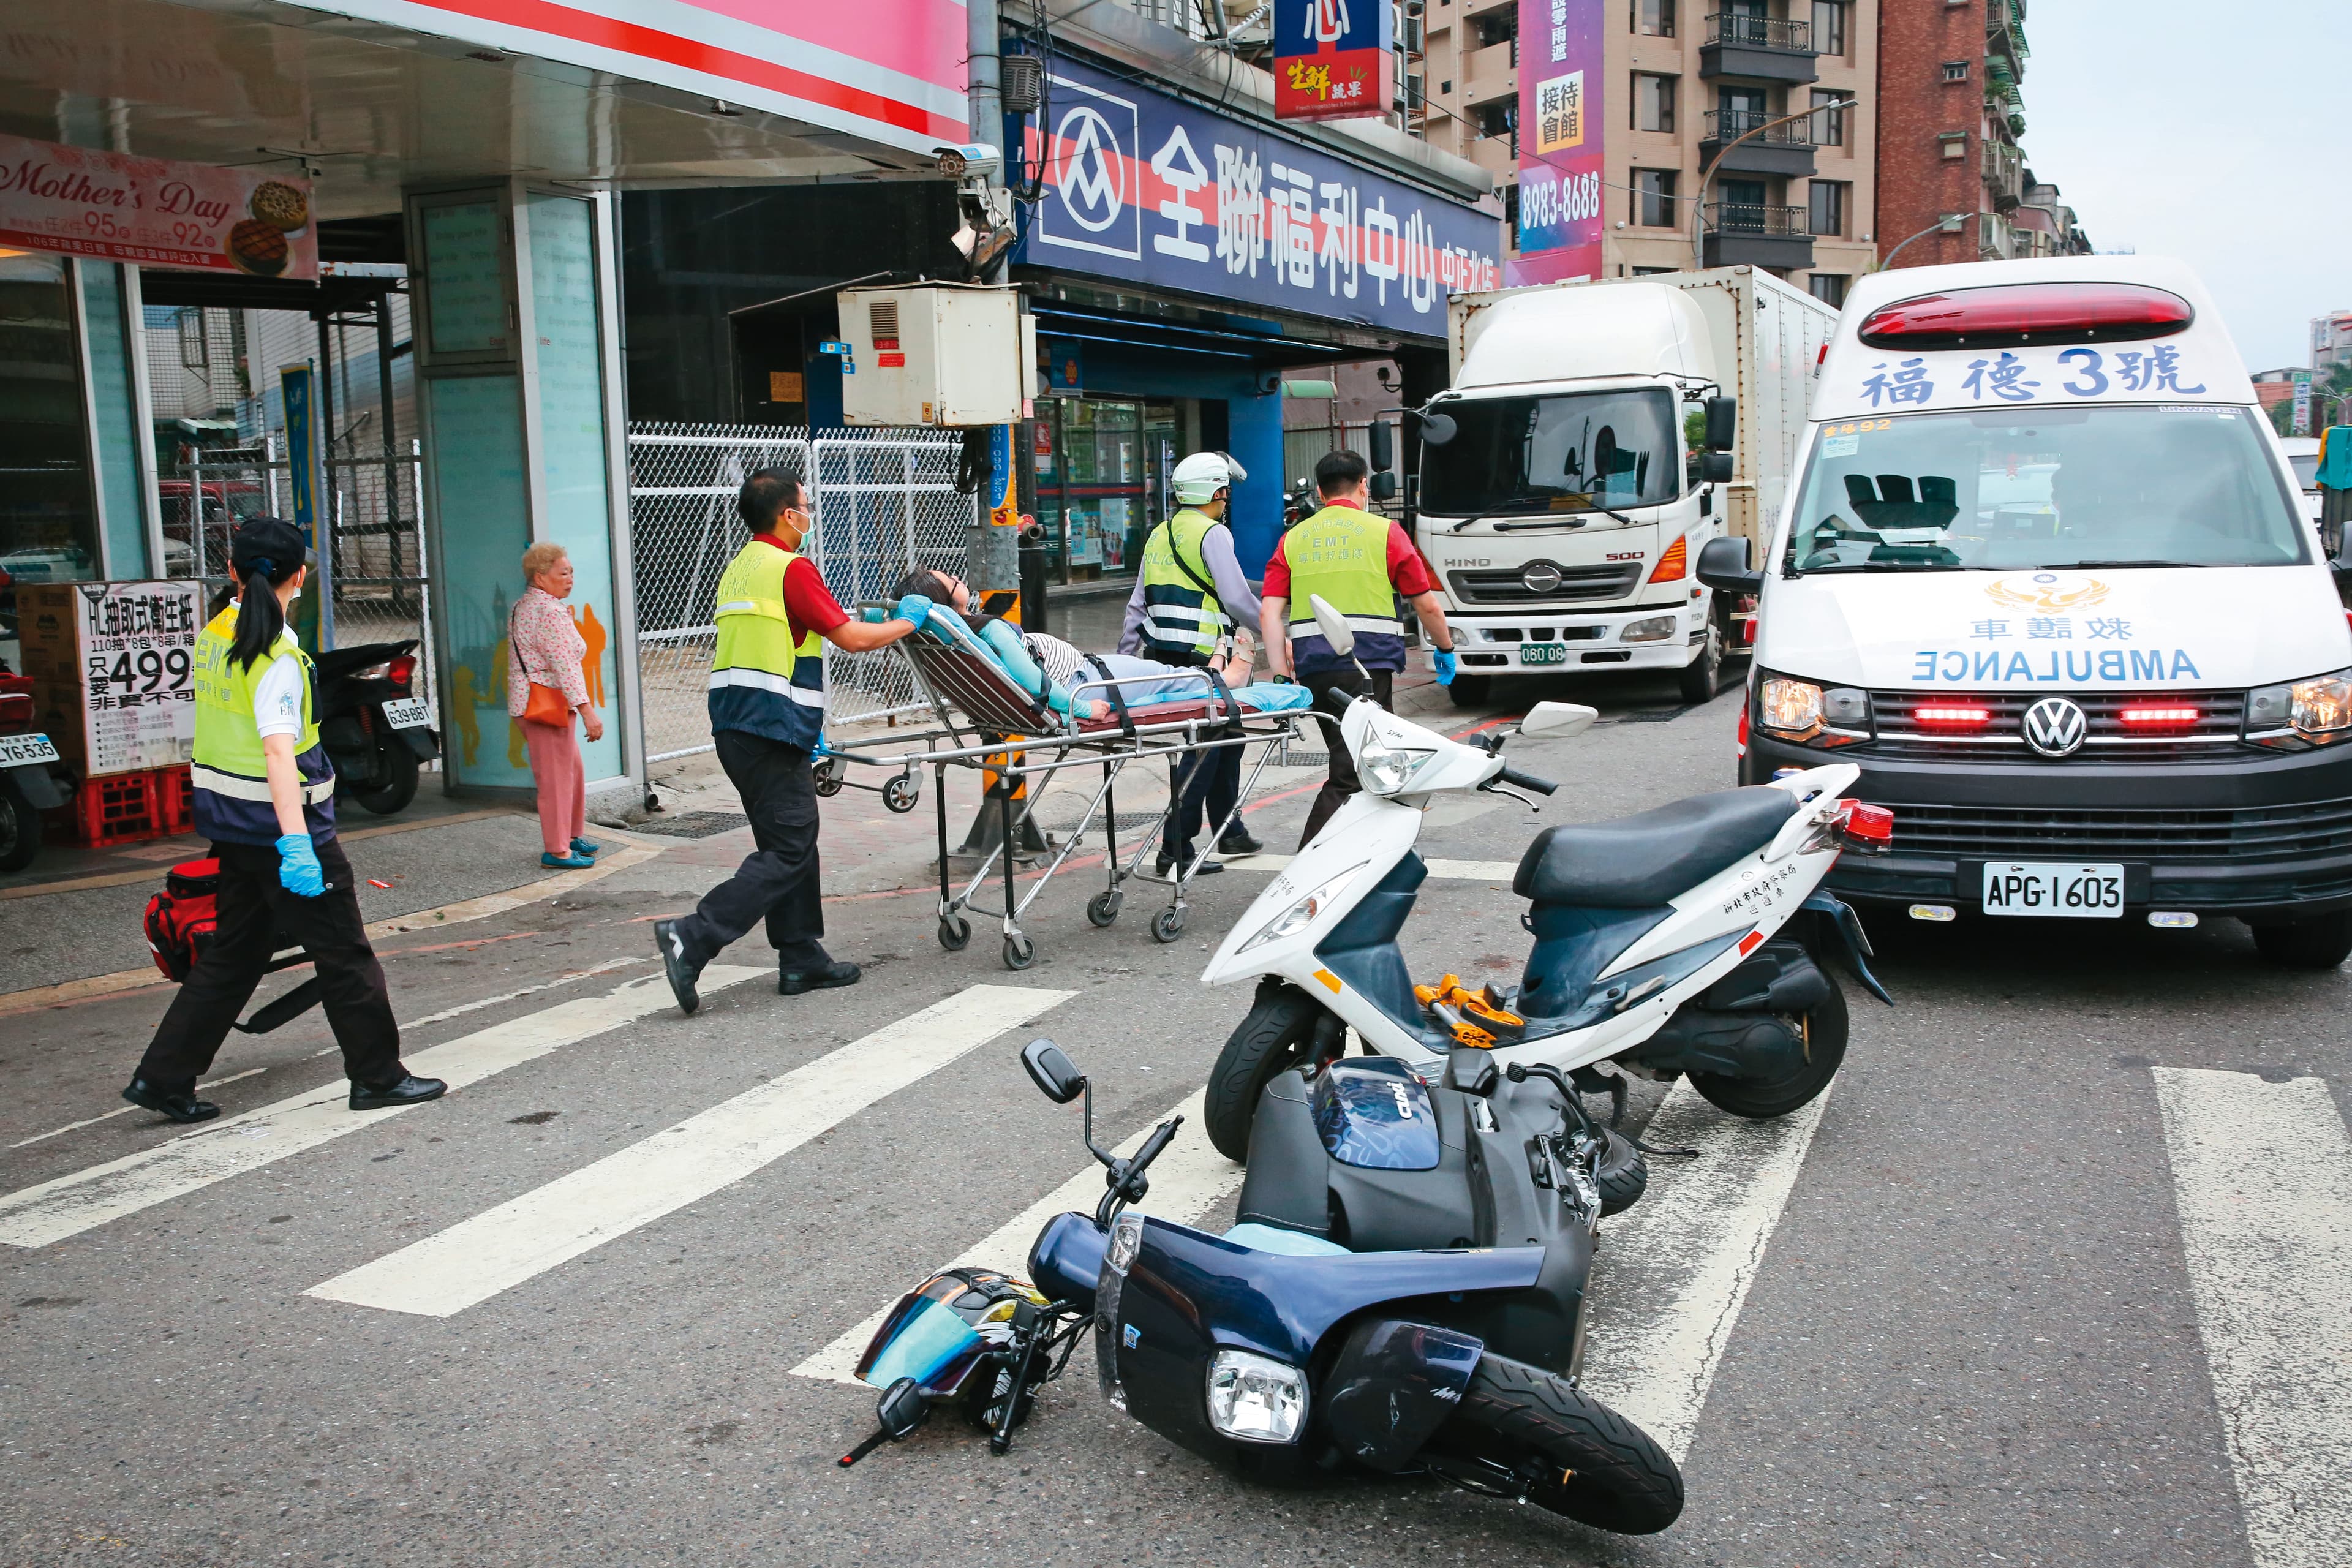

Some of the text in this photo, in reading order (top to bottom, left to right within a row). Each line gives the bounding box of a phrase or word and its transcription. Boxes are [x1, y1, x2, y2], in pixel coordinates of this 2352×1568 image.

[1303, 0, 1351, 42] 心
[0, 160, 143, 209] Mother's
[155, 181, 231, 228] Day
[1523, 171, 1599, 230] 8983-8688
[1150, 124, 1437, 314] 全聯福利中心
[1442, 241, 1494, 294] 中正北店
[1313, 535, 1349, 548] EMT
[1144, 552, 1177, 566] POLIC
[1444, 559, 1491, 567] HINO
[1606, 551, 1645, 561] 500
[109, 648, 190, 693] 499
[89, 689, 195, 711] 非買不可
[388, 706, 430, 725] 639-BBT
[1387, 729, 1403, 739] SYM
[1988, 876, 2120, 908] APG-1603
